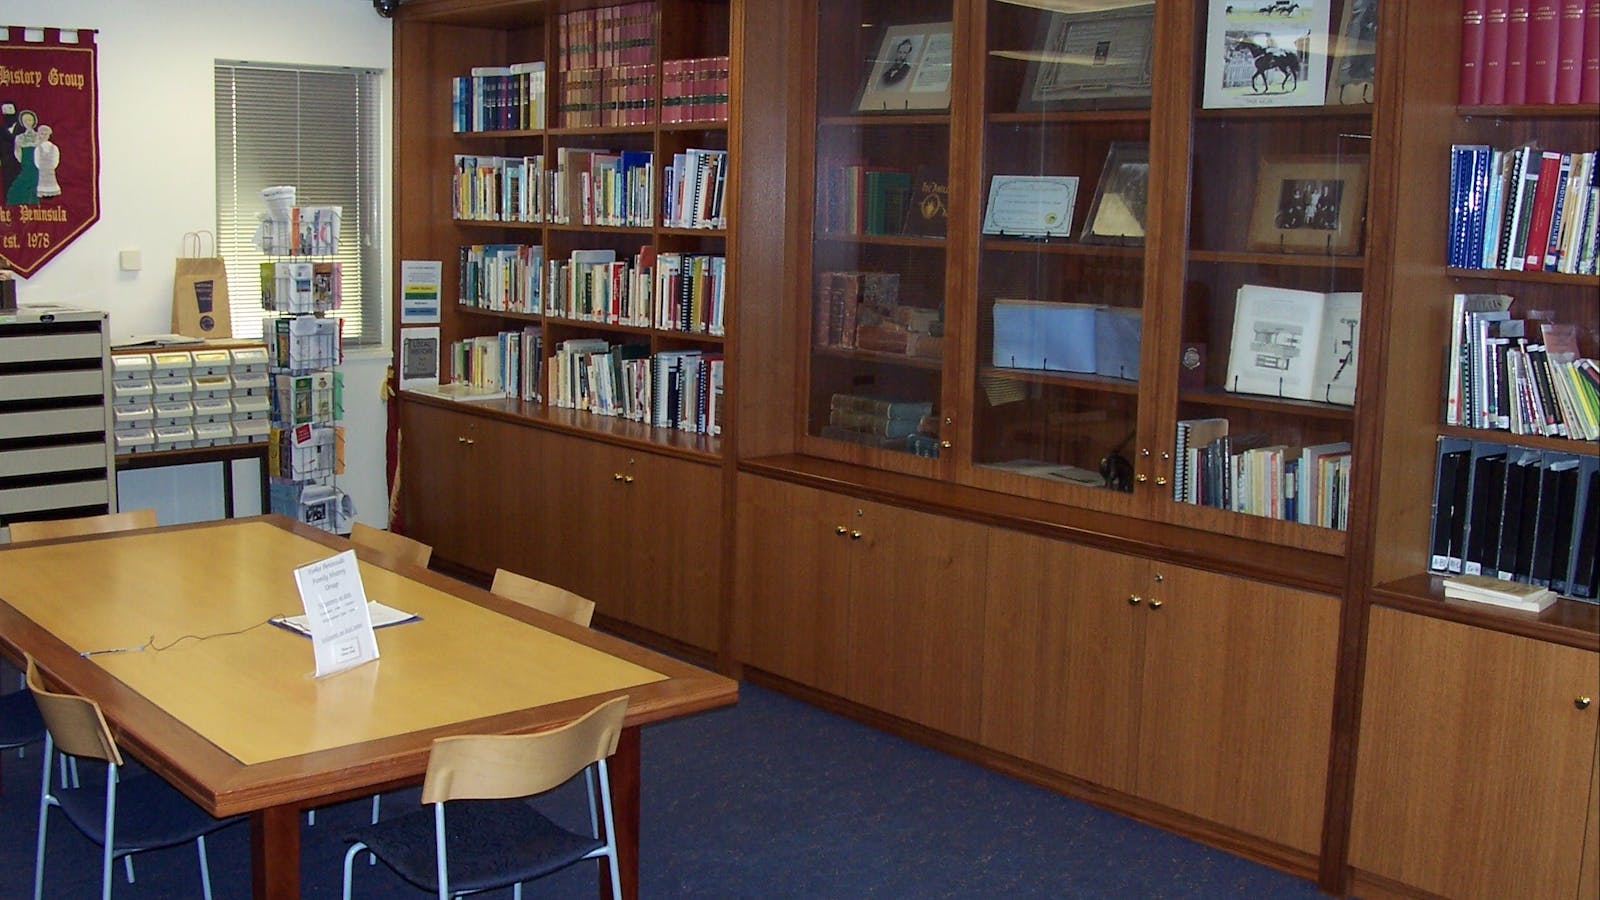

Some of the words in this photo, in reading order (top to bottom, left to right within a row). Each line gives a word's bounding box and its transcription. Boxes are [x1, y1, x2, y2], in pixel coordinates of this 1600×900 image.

[48, 67, 84, 90] Group
[1557, 176, 1567, 208] FINDING
[19, 204, 67, 223] Peninsula
[1551, 210, 1561, 245] FAMILIES
[3, 234, 20, 248] est.
[27, 233, 50, 248] 1978
